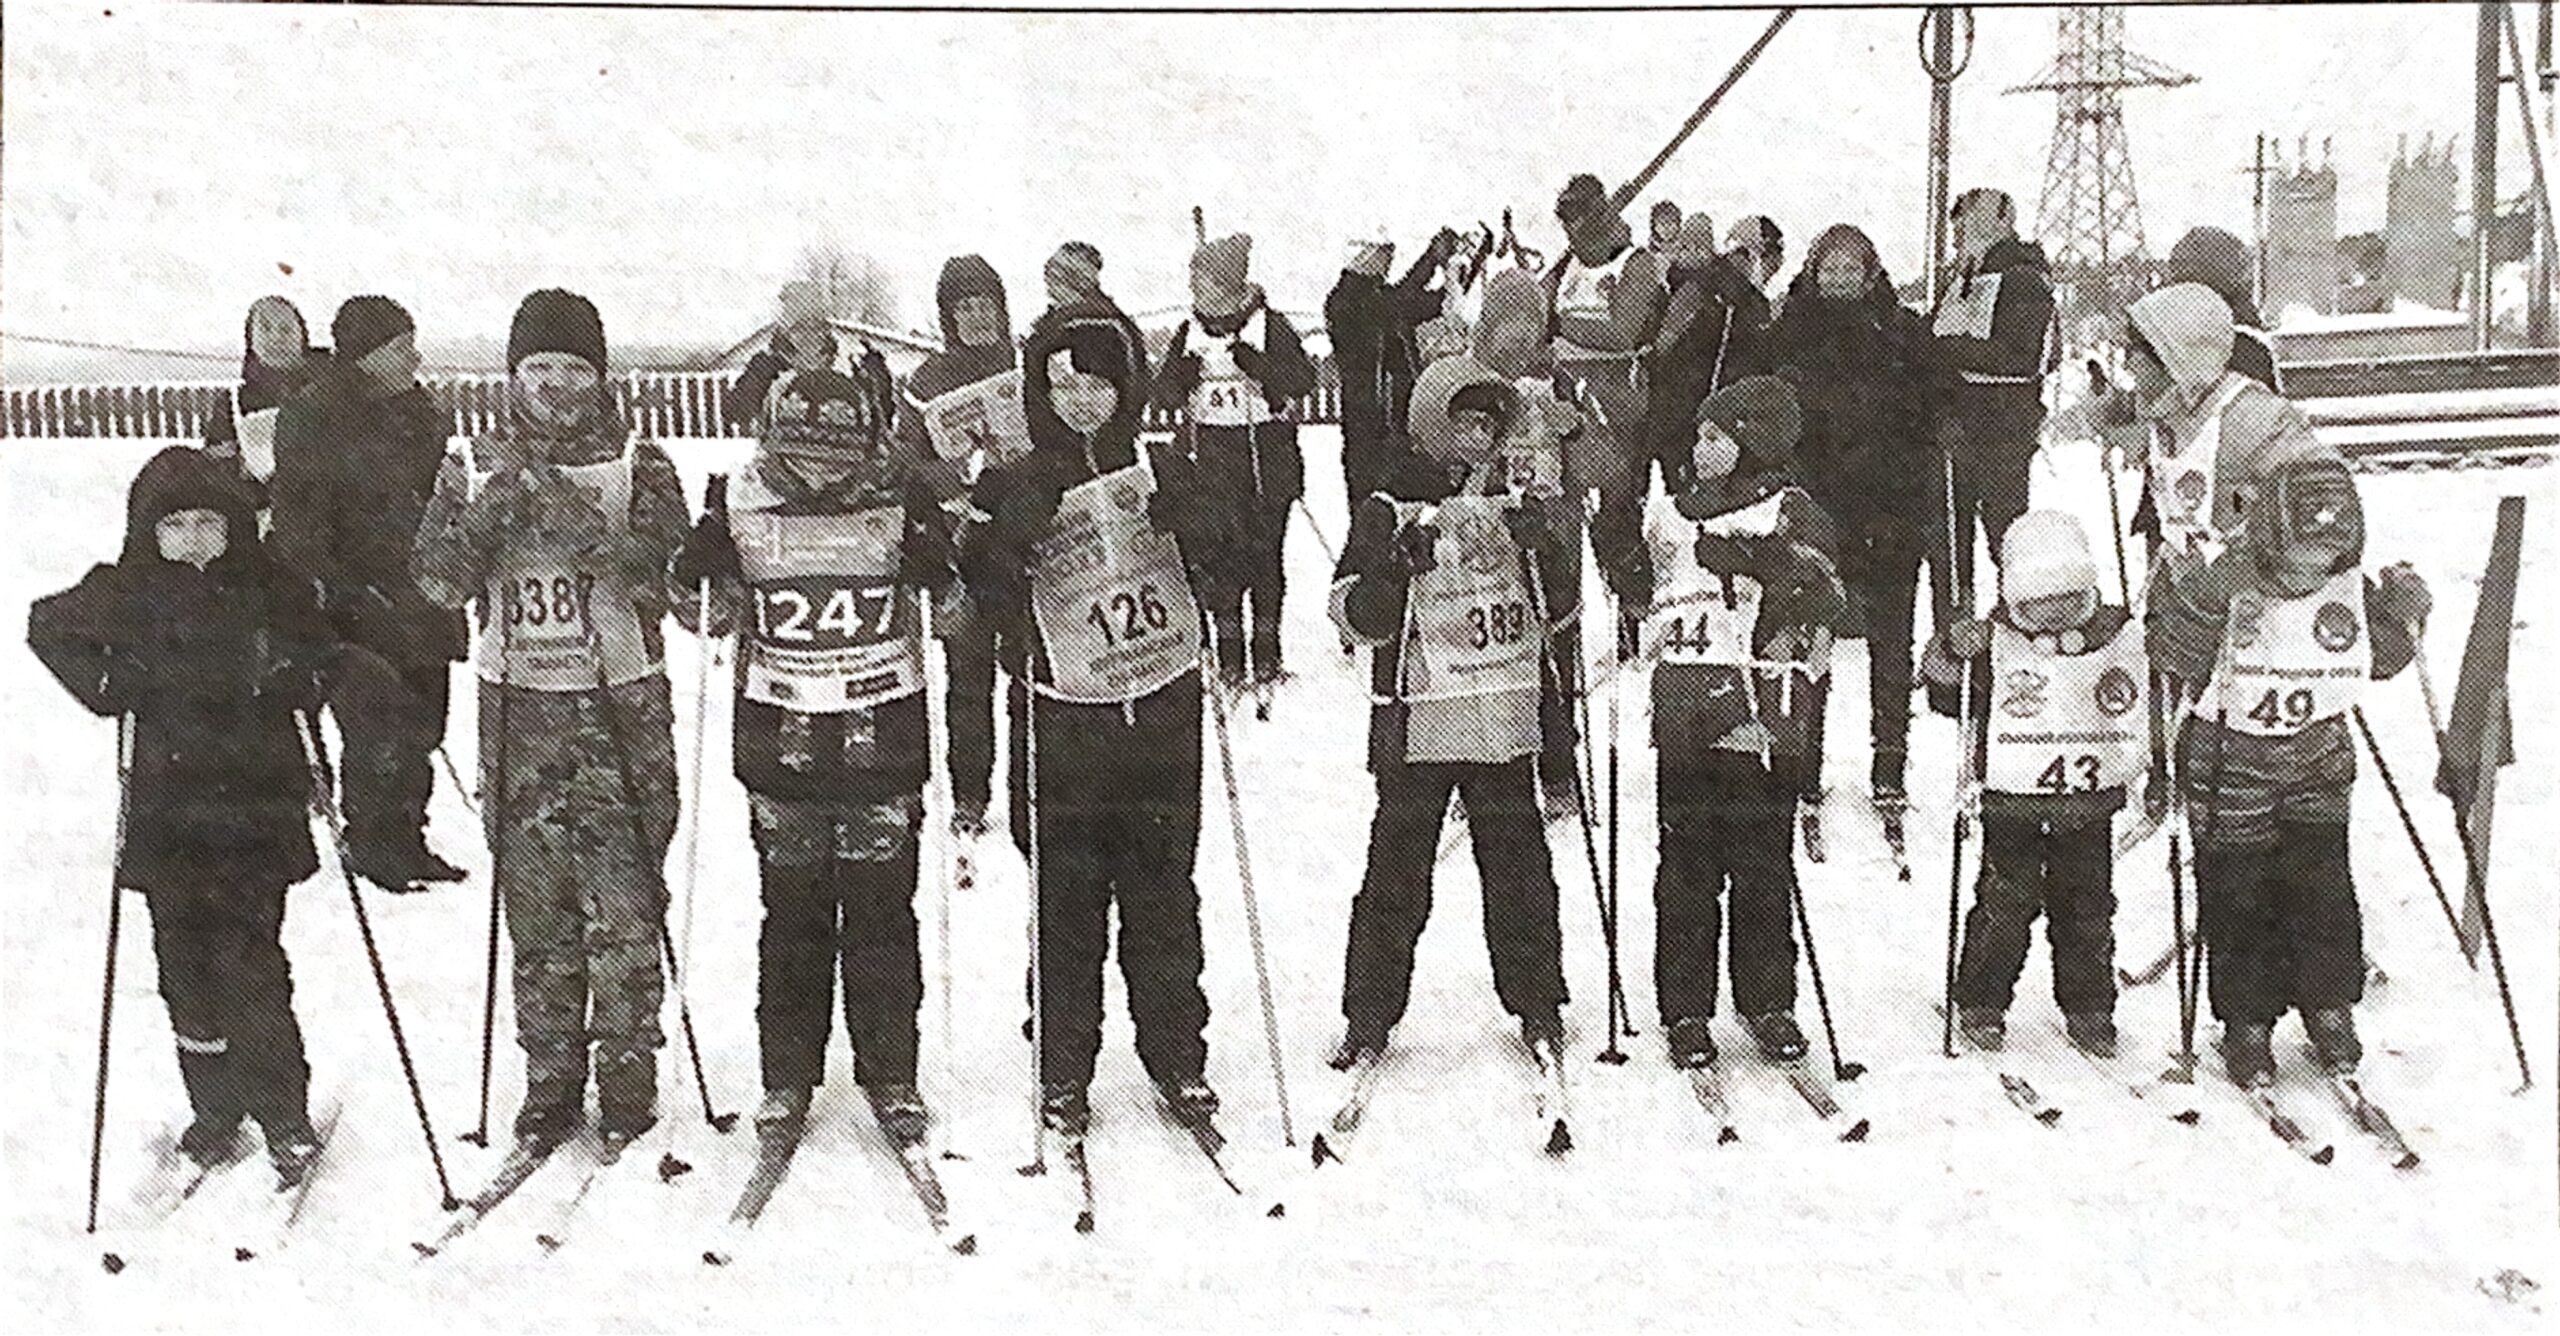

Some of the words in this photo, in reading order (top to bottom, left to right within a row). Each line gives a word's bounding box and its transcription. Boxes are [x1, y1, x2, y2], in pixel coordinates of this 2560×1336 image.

[755, 585, 894, 642] 1247
[1086, 584, 1168, 646] 126
[1466, 602, 1524, 651] 389
[1662, 612, 1712, 656] 44
[2248, 687, 2316, 729] 49
[2036, 755, 2102, 794] 43
